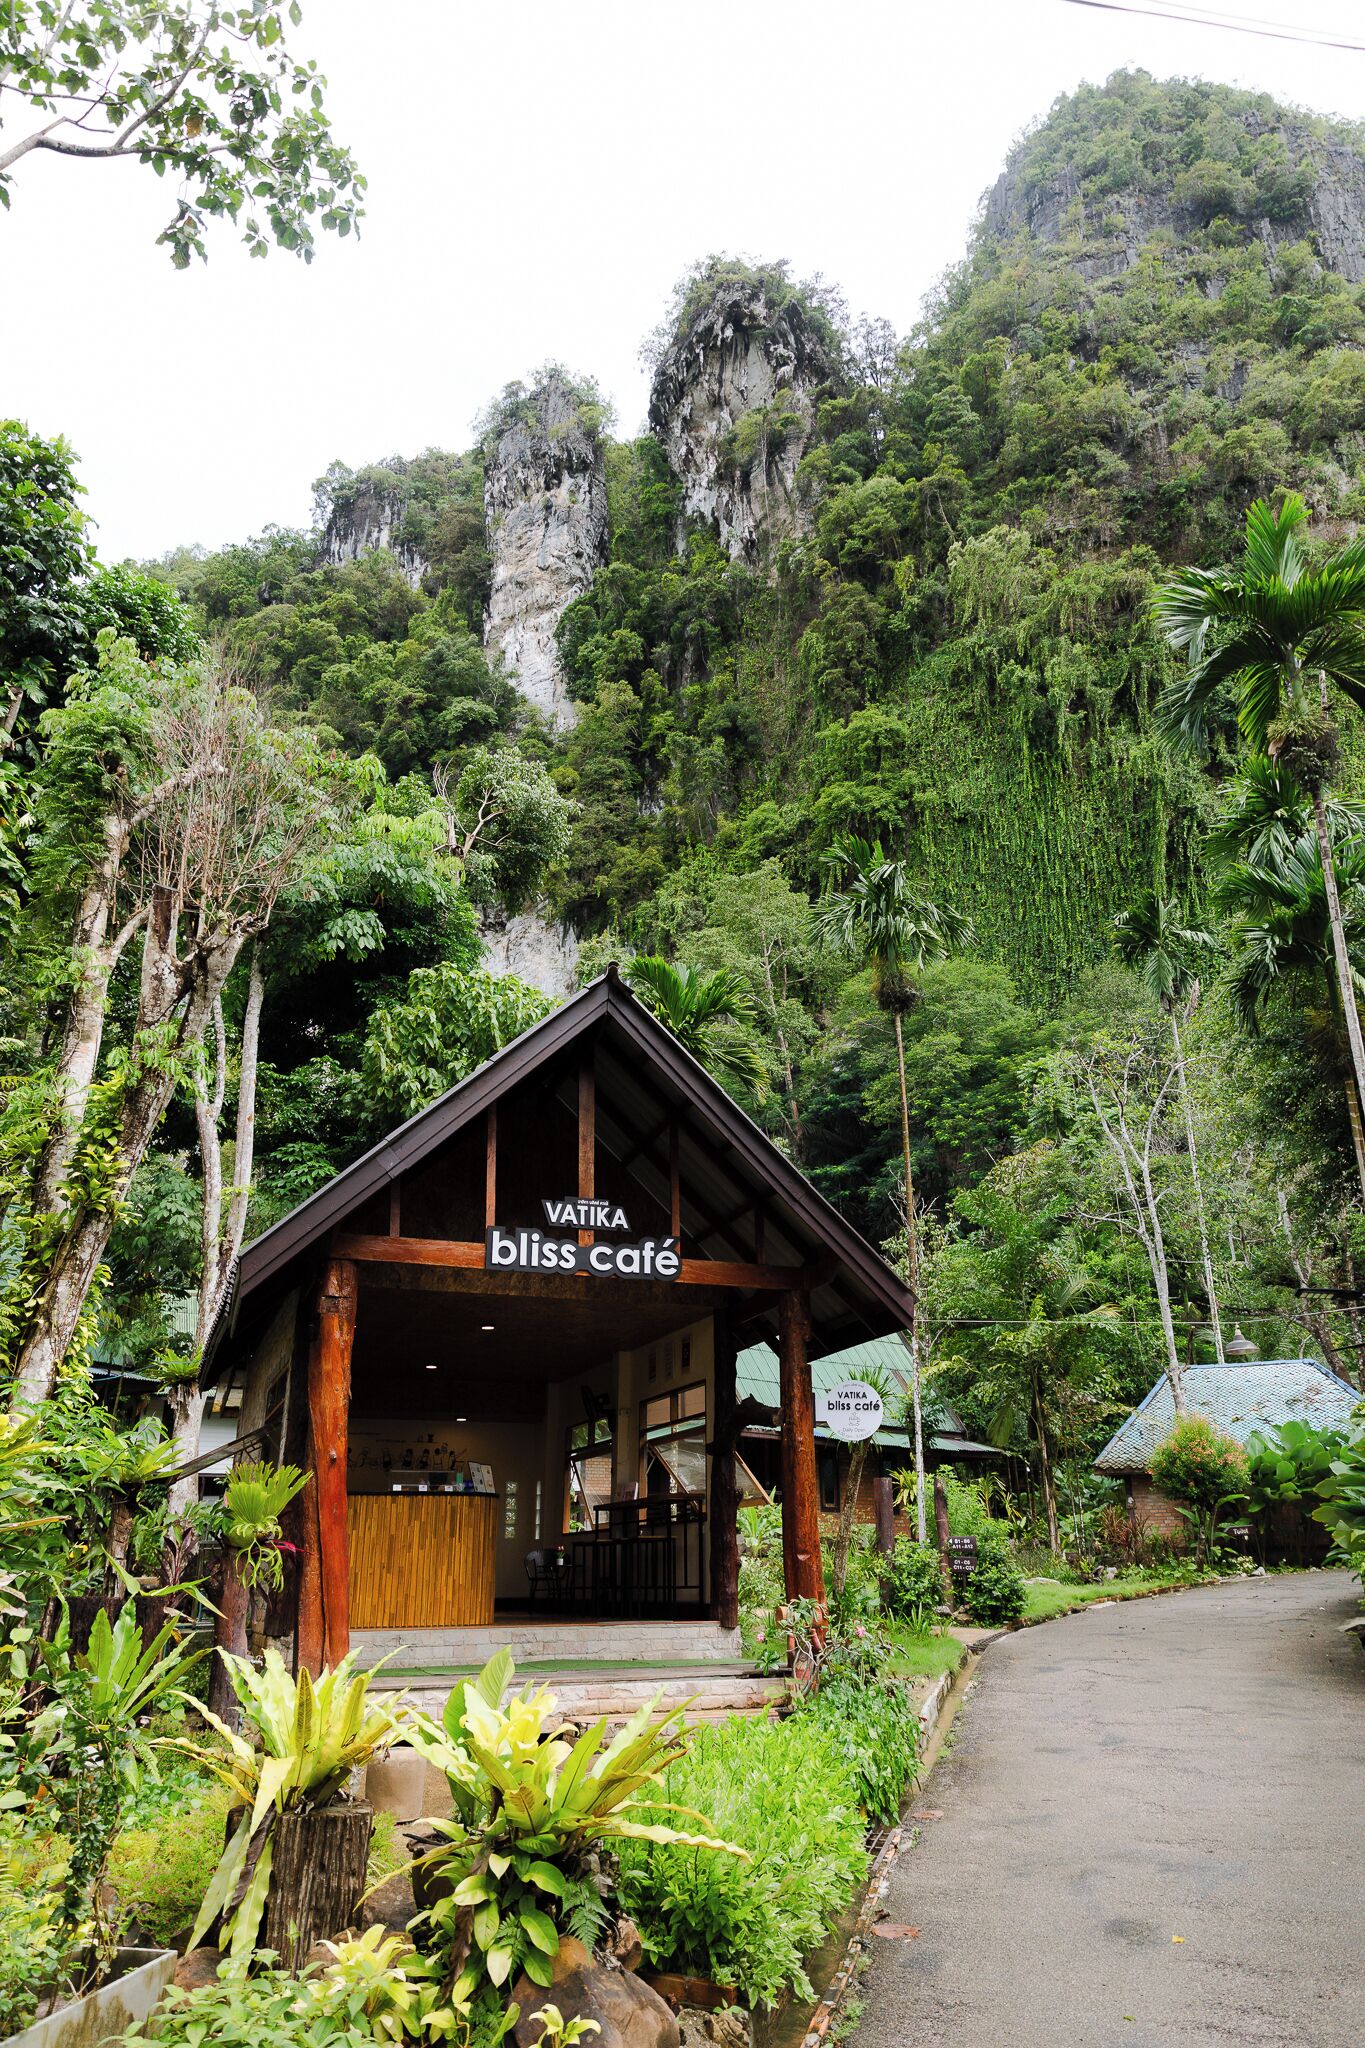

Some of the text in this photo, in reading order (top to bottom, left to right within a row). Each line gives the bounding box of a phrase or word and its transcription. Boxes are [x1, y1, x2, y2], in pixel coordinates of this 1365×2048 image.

[545, 1201, 629, 1229] VATIKA
[491, 1231, 679, 1276] bliss café
[837, 1391, 868, 1399] VATIKA
[828, 1400, 880, 1411] bliss café
